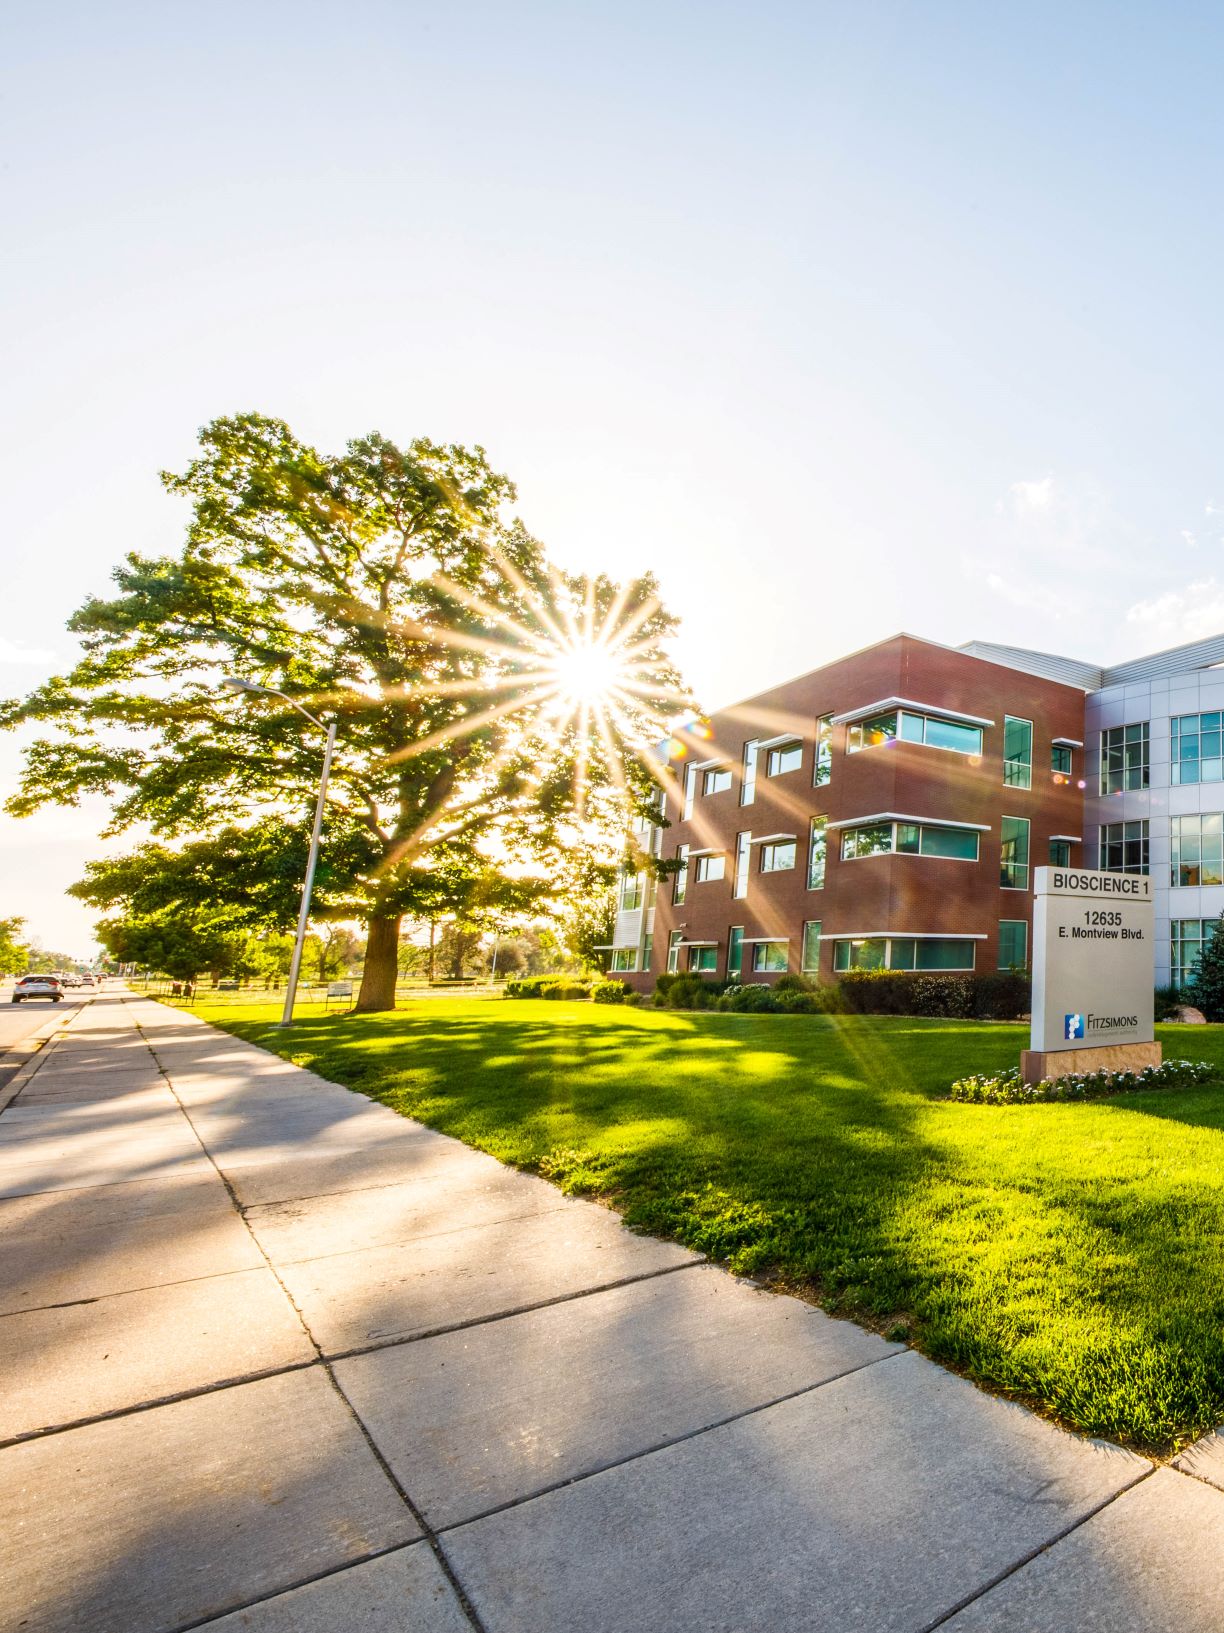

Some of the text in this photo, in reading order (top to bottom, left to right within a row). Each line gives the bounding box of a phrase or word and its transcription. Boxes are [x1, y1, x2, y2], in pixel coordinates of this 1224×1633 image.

[1053, 873, 1149, 895] BIOSCIENCE 1
[1084, 911, 1122, 926] 12635
[1058, 927, 1145, 940] E. Montview Blvd.
[1087, 1014, 1138, 1030] FITZSIMONS
